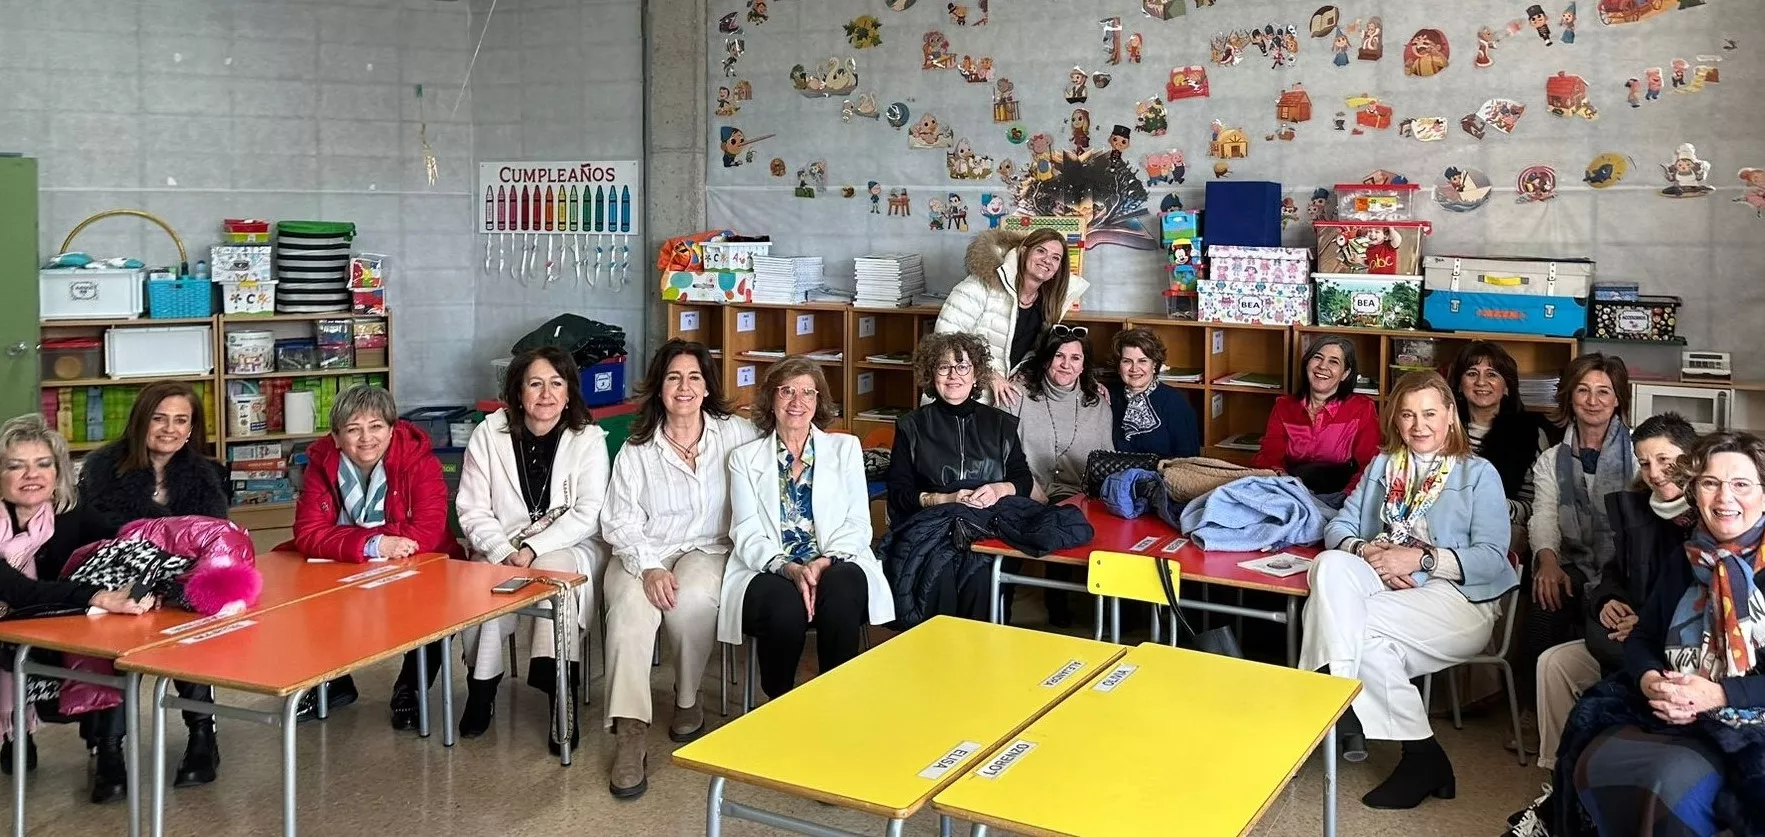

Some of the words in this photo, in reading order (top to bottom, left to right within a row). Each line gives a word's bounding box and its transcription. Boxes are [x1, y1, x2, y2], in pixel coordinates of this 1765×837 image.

[499, 163, 616, 183] CUMPLEAÑOS
[1241, 301, 1260, 309] BEA
[1357, 299, 1376, 308] BEA
[1044, 661, 1082, 686] ALEJANDRA
[1102, 669, 1129, 687] OLIVIA
[933, 749, 968, 769] ELISA
[983, 743, 1030, 776] LORENZO
